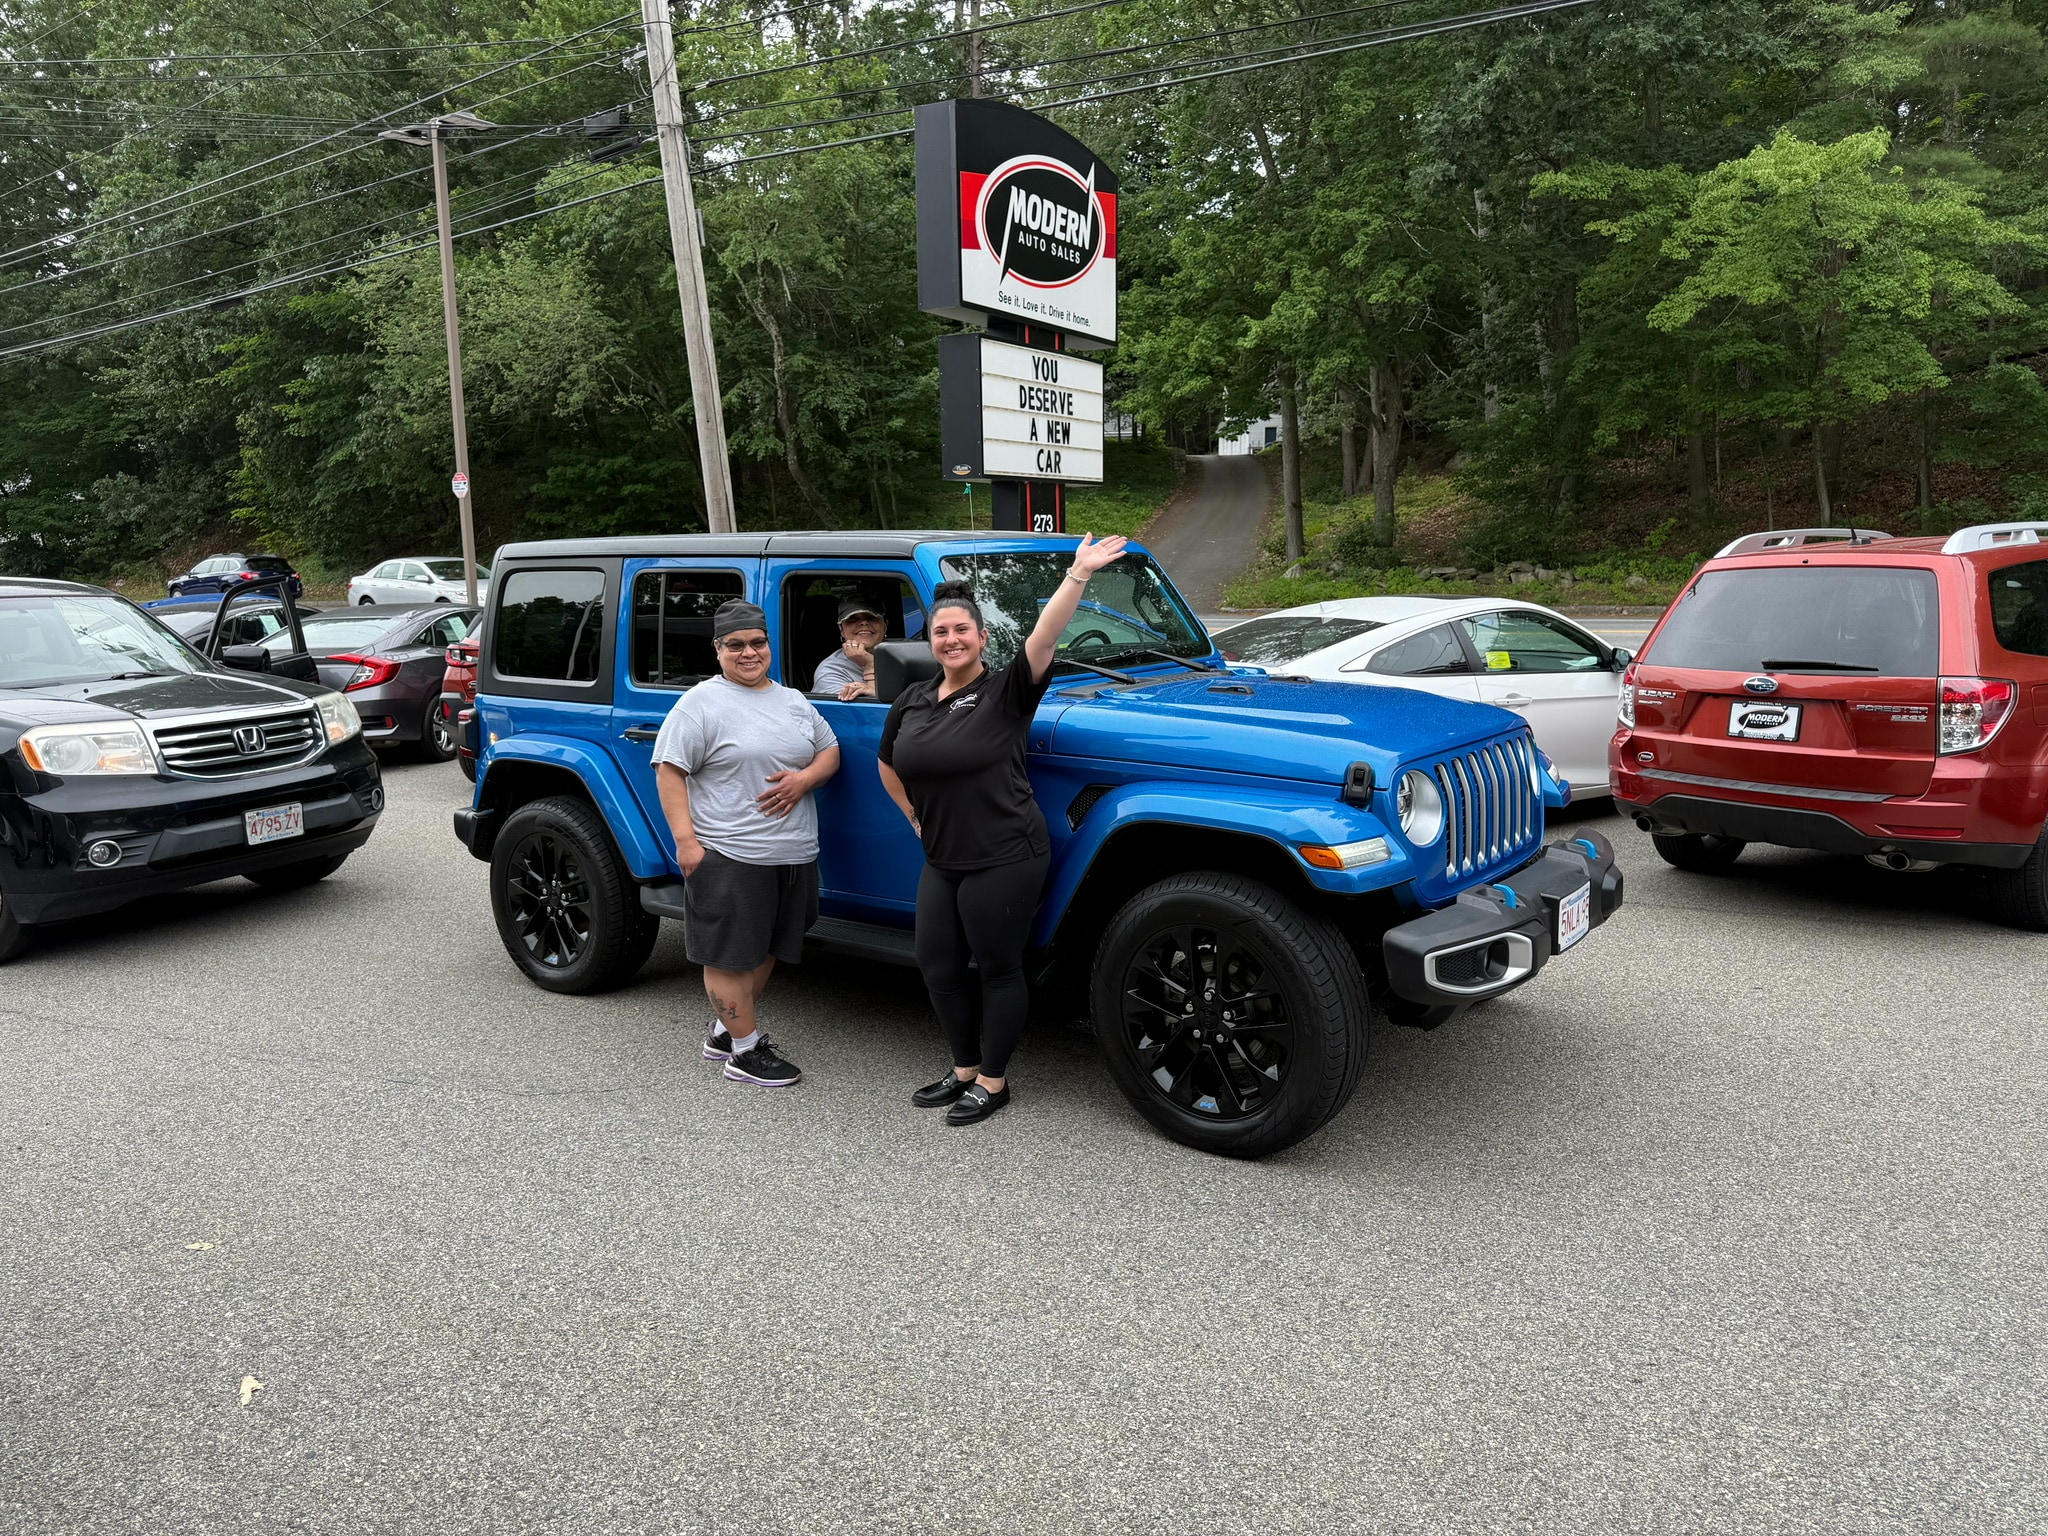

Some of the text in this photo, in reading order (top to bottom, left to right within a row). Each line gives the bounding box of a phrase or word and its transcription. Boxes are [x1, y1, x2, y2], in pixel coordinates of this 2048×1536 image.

[1018, 230, 1081, 264] AUTO SALES
[998, 290, 1012, 305] See
[1022, 297, 1039, 313] Love
[1048, 305, 1065, 320] Drive
[1066, 310, 1071, 322] it
[1072, 312, 1091, 327] home.
[1032, 355, 1058, 383] YOU
[1019, 385, 1074, 416] DESERVE
[1030, 417, 1071, 445] A NEW
[1036, 448, 1062, 474] CAR
[1033, 514, 1054, 533] 273
[1745, 711, 1787, 725] MODERN
[1856, 704, 1929, 714] FORESTER
[251, 815, 282, 836] 4795
[285, 812, 300, 830] ZV
